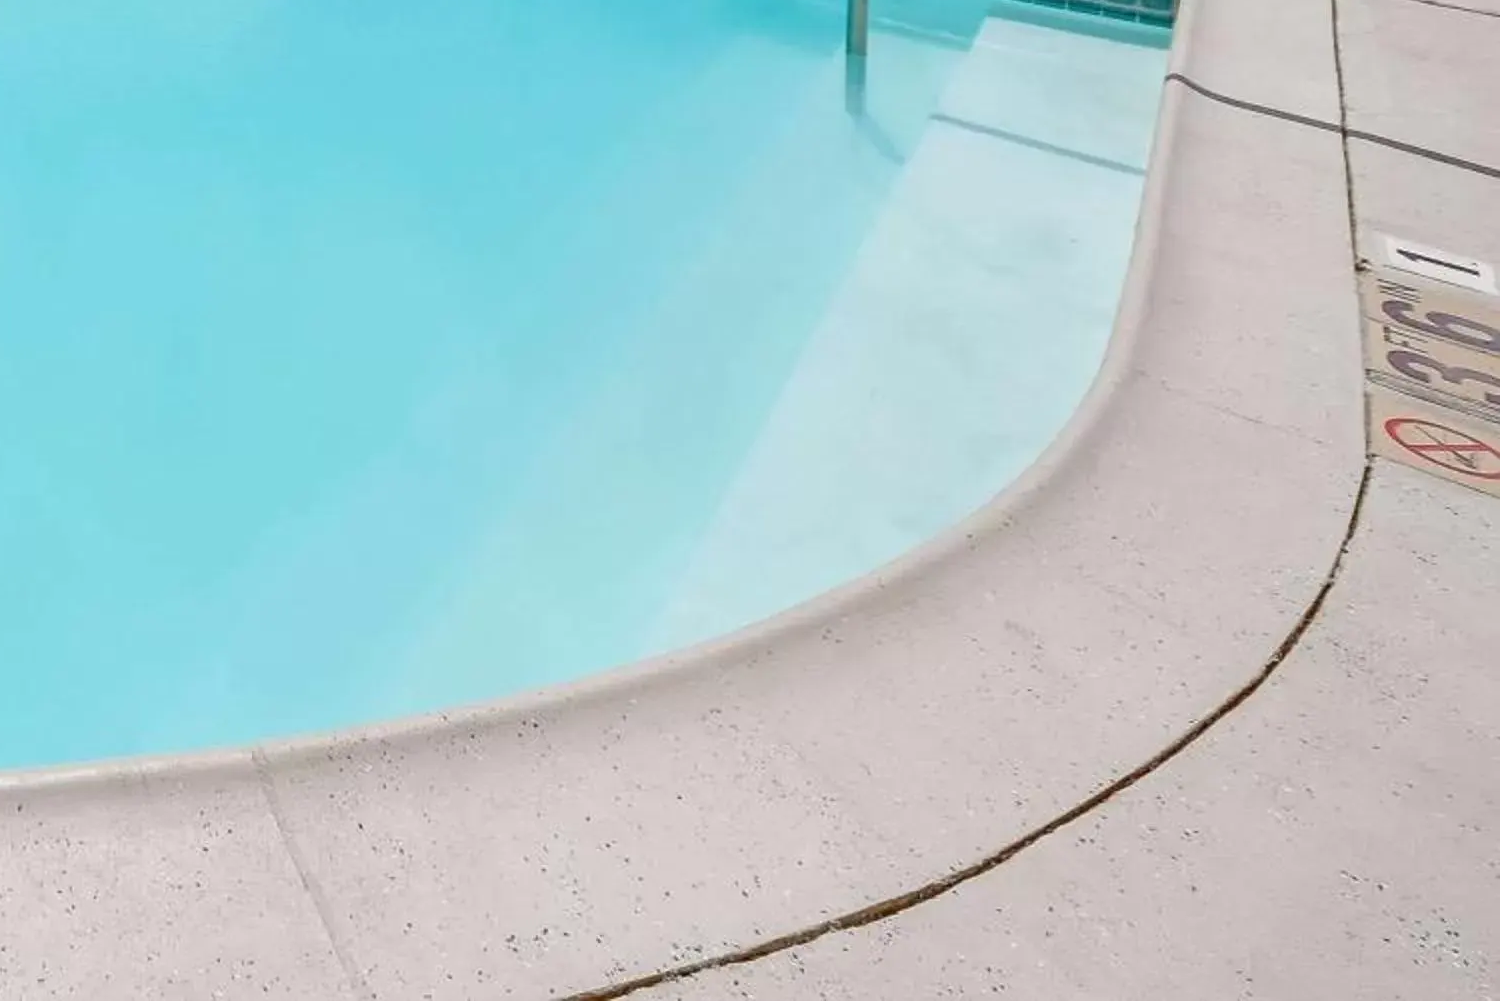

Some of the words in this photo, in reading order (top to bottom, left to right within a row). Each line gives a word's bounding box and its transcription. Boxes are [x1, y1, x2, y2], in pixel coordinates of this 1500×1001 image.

[1380, 299, 1500, 353] 6
[1383, 325, 1429, 354] FT
[1386, 350, 1500, 405] 3
